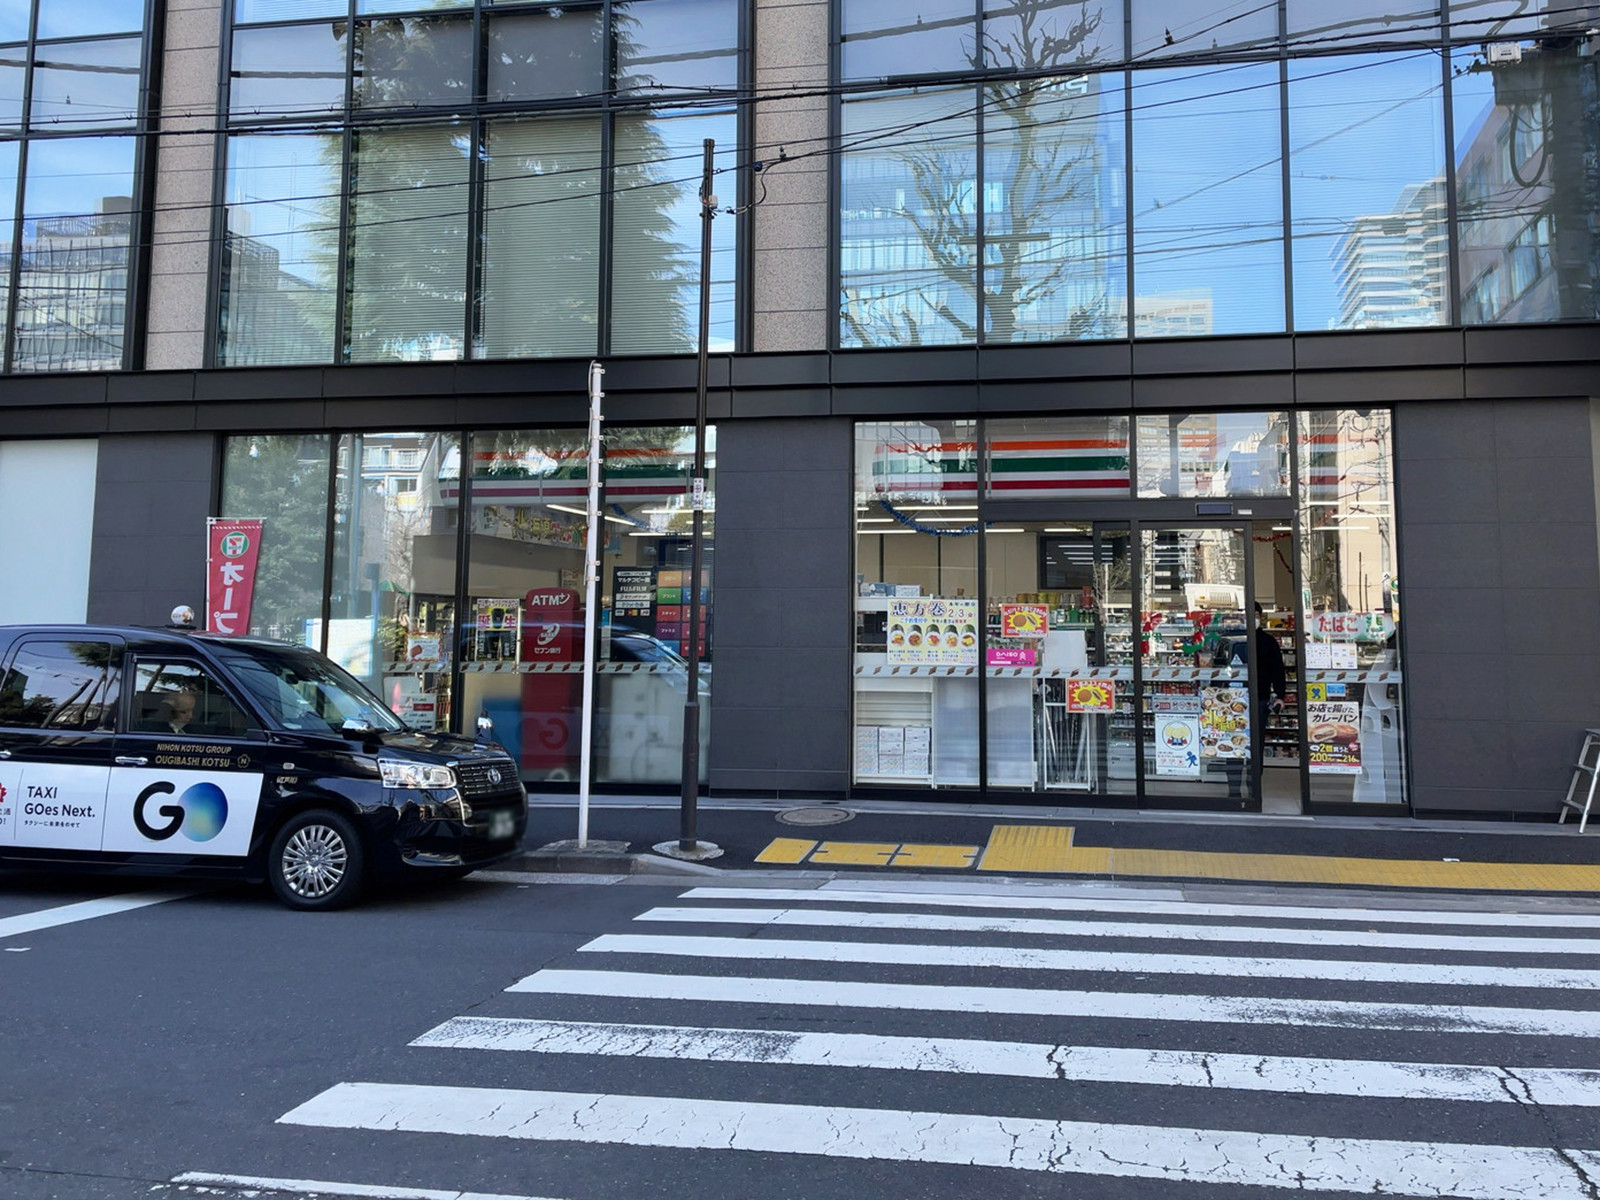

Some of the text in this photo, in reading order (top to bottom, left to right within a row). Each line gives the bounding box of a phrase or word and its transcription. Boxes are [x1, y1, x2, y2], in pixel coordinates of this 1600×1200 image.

[1319, 616, 1358, 632] たばこ
[1308, 703, 1354, 714] お店で揚げた
[156, 743, 232, 754] NIHON KOTSU GROUP
[155, 755, 230, 767] OUGIBASHI KOTSU
[27, 786, 58, 799] TAXI
[24, 803, 96, 818] GOes Next.
[133, 781, 229, 843] GO
